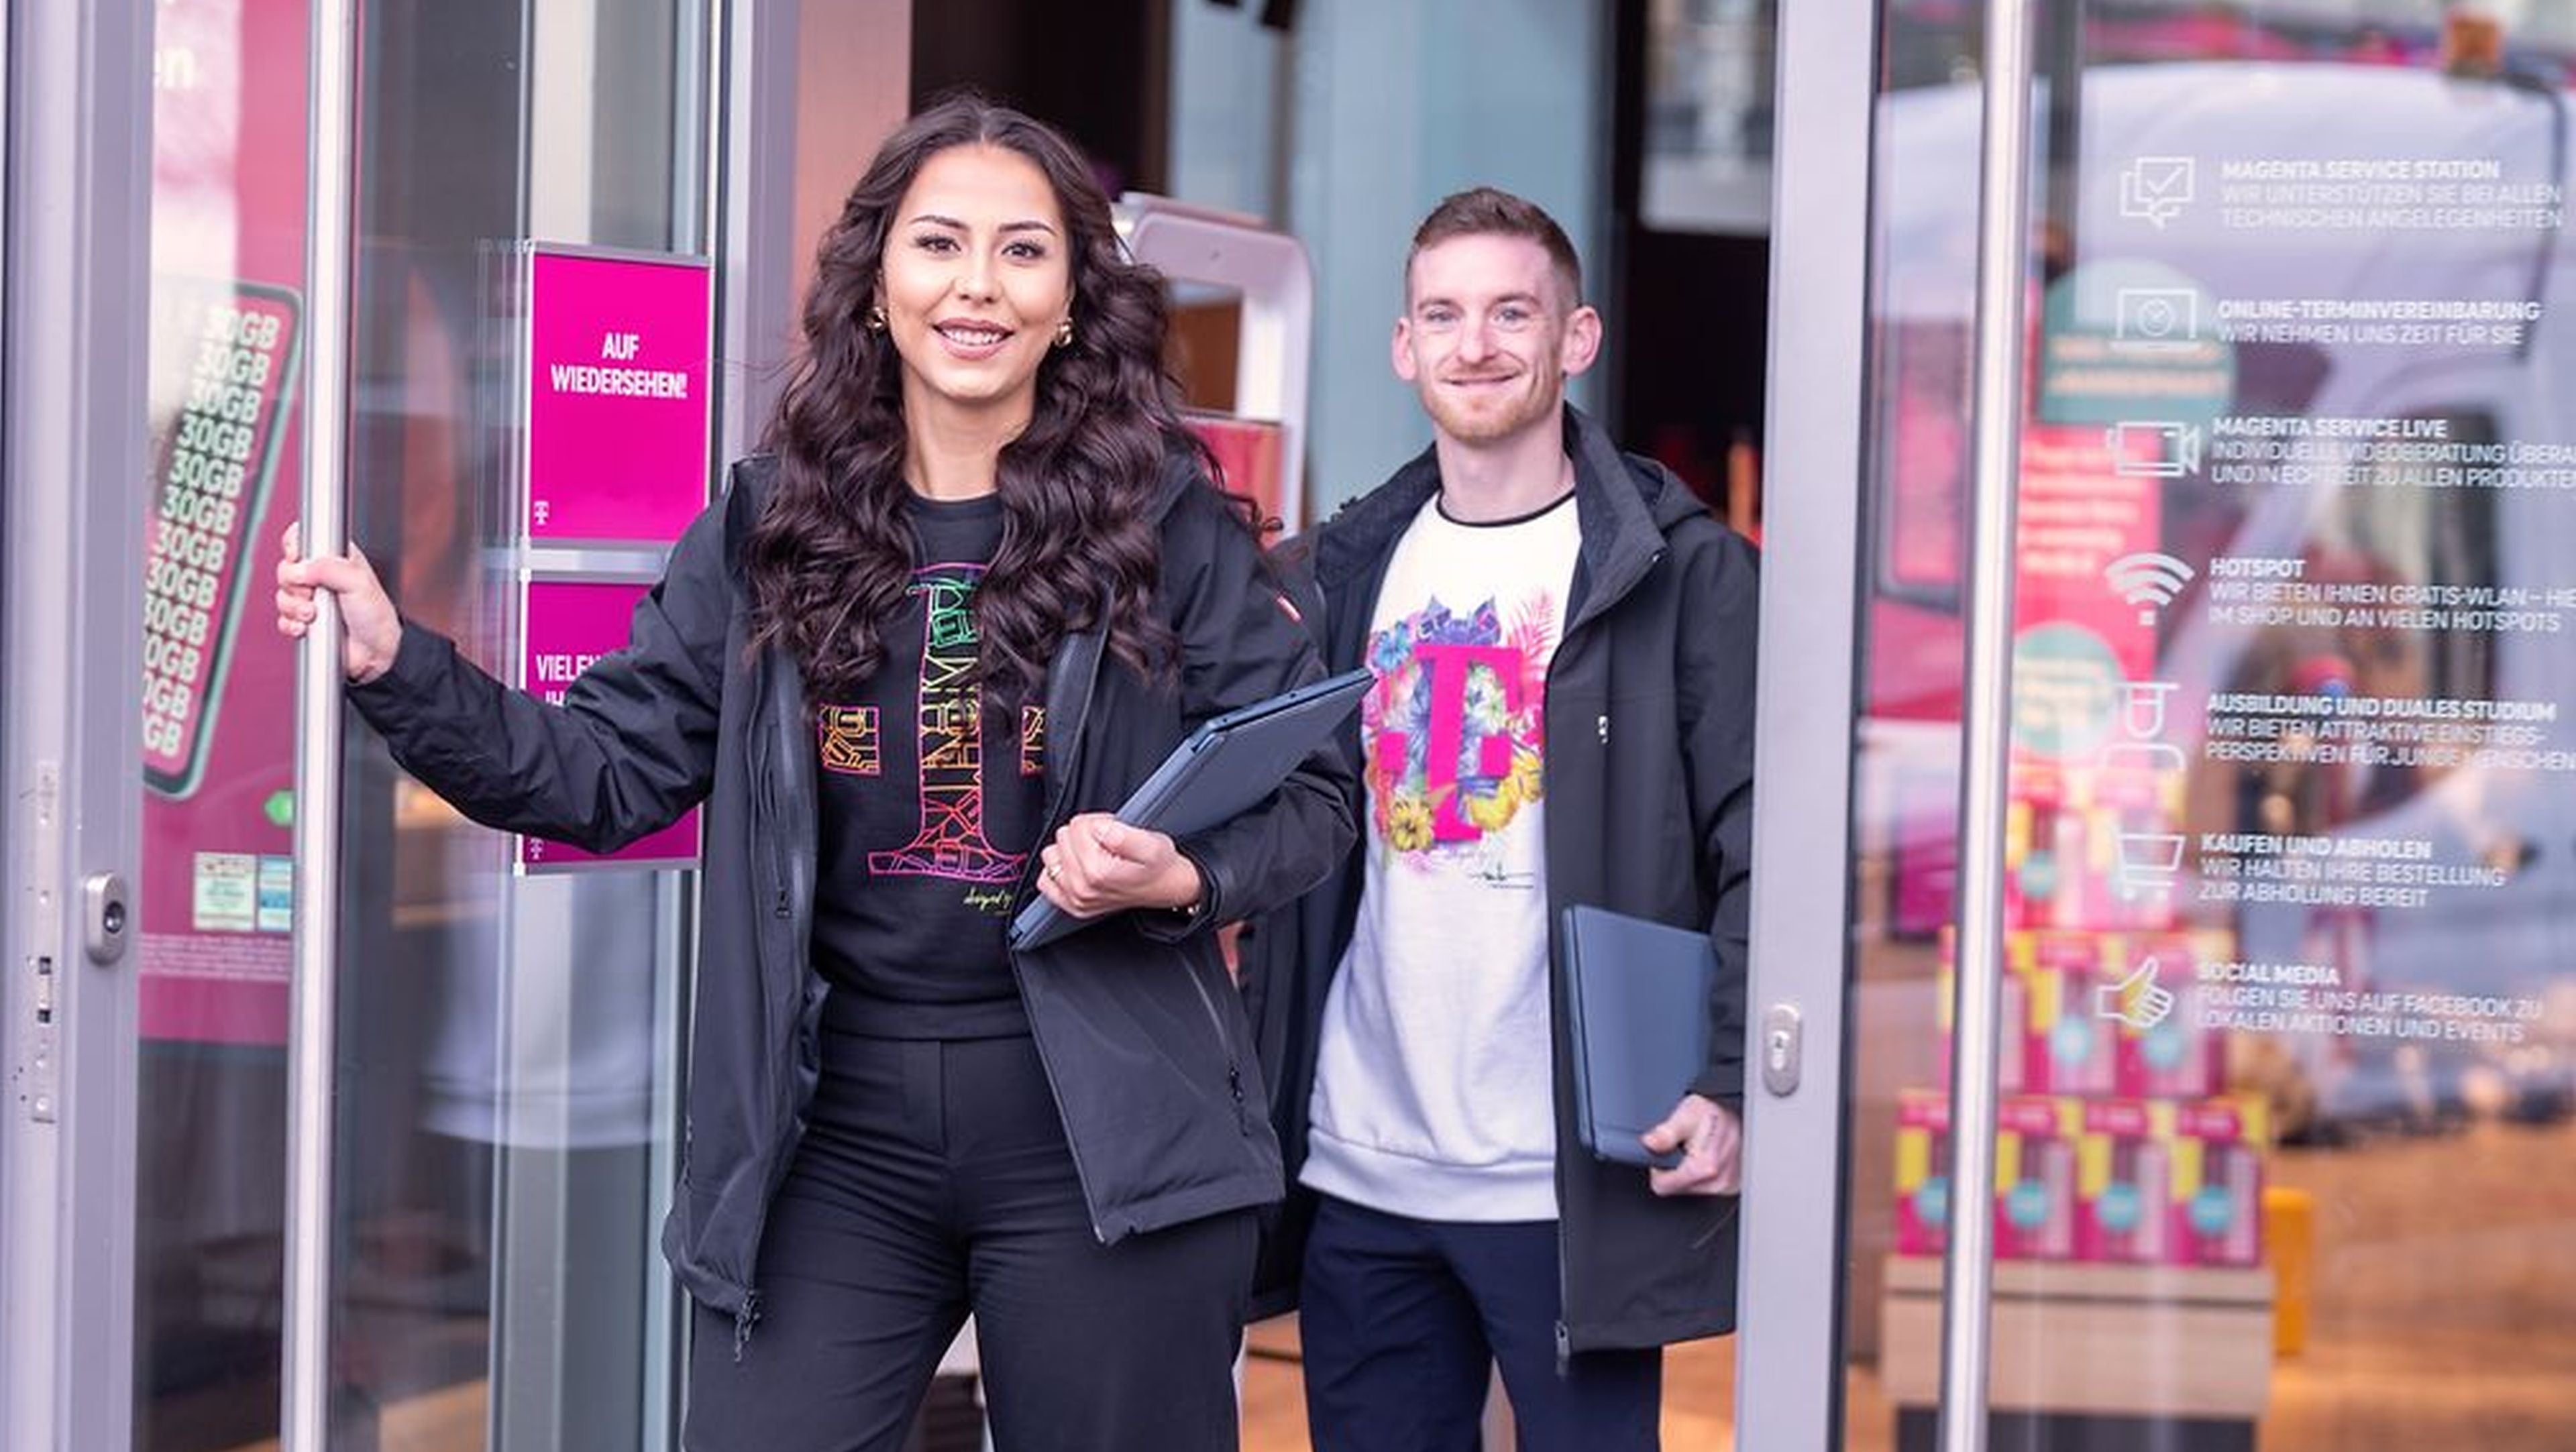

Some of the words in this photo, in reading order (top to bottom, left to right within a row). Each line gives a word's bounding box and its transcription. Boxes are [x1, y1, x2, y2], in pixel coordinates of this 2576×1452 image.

[2221, 160, 2319, 180] MAGENTA
[2325, 160, 2412, 180] SERVICE
[2415, 160, 2500, 178] STATION
[2220, 184, 2265, 203] WIR
[2267, 182, 2424, 203] UNTERSTÜTZEN
[2428, 184, 2459, 203] SIE
[2463, 184, 2496, 203] BEI
[2496, 184, 2561, 203] ALLEN
[2222, 208, 2362, 228] TECHNISCHEN
[2365, 208, 2562, 228] ANGELEGENHEITEN
[2218, 300, 2542, 321] ONLINE-TERMINVEREINBARUNG
[602, 332, 639, 359] AUF
[2220, 325, 2258, 343] WIR
[2261, 325, 2349, 343] NEHMEN
[2353, 325, 2397, 343] UNS
[2400, 325, 2442, 343] ZEIT
[2445, 320, 2487, 344] FÜR
[2491, 325, 2522, 344] SIE
[194, 341, 270, 387] 30GB
[550, 364, 688, 398] WIEDERSEHEN!
[185, 378, 261, 424] 30GB
[176, 412, 254, 461] 30GB
[2213, 417, 2310, 437] MAGENTA
[2314, 418, 2402, 437] SERVICE
[2403, 419, 2448, 437] LIVE
[2212, 441, 2344, 461] INDIVIDUELLE
[2347, 443, 2506, 463] VIDEOBERATUNG
[2508, 439, 2576, 465] ÜBERA
[169, 449, 245, 498] 30GB
[2212, 465, 2254, 483] UND
[2257, 465, 2279, 483] IN
[2282, 465, 2373, 485] ECHTZEIT
[2375, 467, 2400, 486] ZU
[2402, 467, 2463, 487] ALLEN
[2467, 467, 2576, 489] PRODUKTE
[161, 484, 236, 535] 30GB
[152, 520, 227, 572] 30GB
[2210, 559, 2306, 577] HOTSPOT
[146, 556, 219, 609] 30GB
[2209, 581, 2249, 602] WIR
[2252, 582, 2322, 602] BIETEN
[2324, 583, 2387, 602] IHNEN
[2390, 585, 2527, 607] GRATIS-WLAN
[2209, 607, 2233, 624] IM
[2235, 607, 2293, 625] SHOP
[2298, 608, 2343, 626] UND
[2343, 609, 2375, 627] AN
[2377, 609, 2449, 628] VIELEN
[2452, 611, 2561, 631] HOTSPOTS
[144, 633, 200, 683] 0GB
[535, 654, 602, 681] VIELE
[2206, 695, 2332, 715] AUSBILDUNG
[2336, 697, 2381, 716] UND
[2382, 698, 2461, 718] DUALES
[2463, 700, 2557, 722] STUDIUM
[143, 713, 182, 757] GB
[2206, 718, 2246, 736] WIR
[2249, 718, 2318, 737] BIETEN
[2319, 720, 2436, 742] ATTRAKTIVE
[2439, 723, 2547, 745] EINSTIEGS-
[2207, 740, 2349, 763] PERSPEKTIVEN
[2350, 742, 2390, 765] FÜR
[2390, 746, 2460, 768] JUNGE
[2201, 834, 2284, 854] KAUFEN
[2286, 836, 2332, 855] UND
[2334, 838, 2432, 859] ABHOLEN
[2201, 858, 2242, 875] WIR
[2244, 859, 2323, 879] HALTEN
[2325, 861, 2373, 882] IHRE
[2376, 864, 2507, 887] BESTELLUNG
[2200, 881, 2241, 899] ZUR
[2242, 883, 2357, 905] ABHOLUNG
[2359, 887, 2428, 907] BEREIT
[2196, 962, 2271, 982] SOCIAL
[2273, 964, 2342, 986] MEDIA
[2198, 986, 2277, 1007] FOLGEN
[2279, 988, 2312, 1009] SIE
[2314, 991, 2359, 1011] UNS
[2359, 992, 2404, 1013] AUF
[2404, 994, 2512, 1017] FACEBOOK
[2514, 997, 2545, 1019] ZU
[2196, 1009, 2284, 1029] LOKALEN
[2287, 1013, 2392, 1036] AKTIONEN
[2395, 1018, 2442, 1038] UND
[2445, 1019, 2526, 1043] EVENTS
